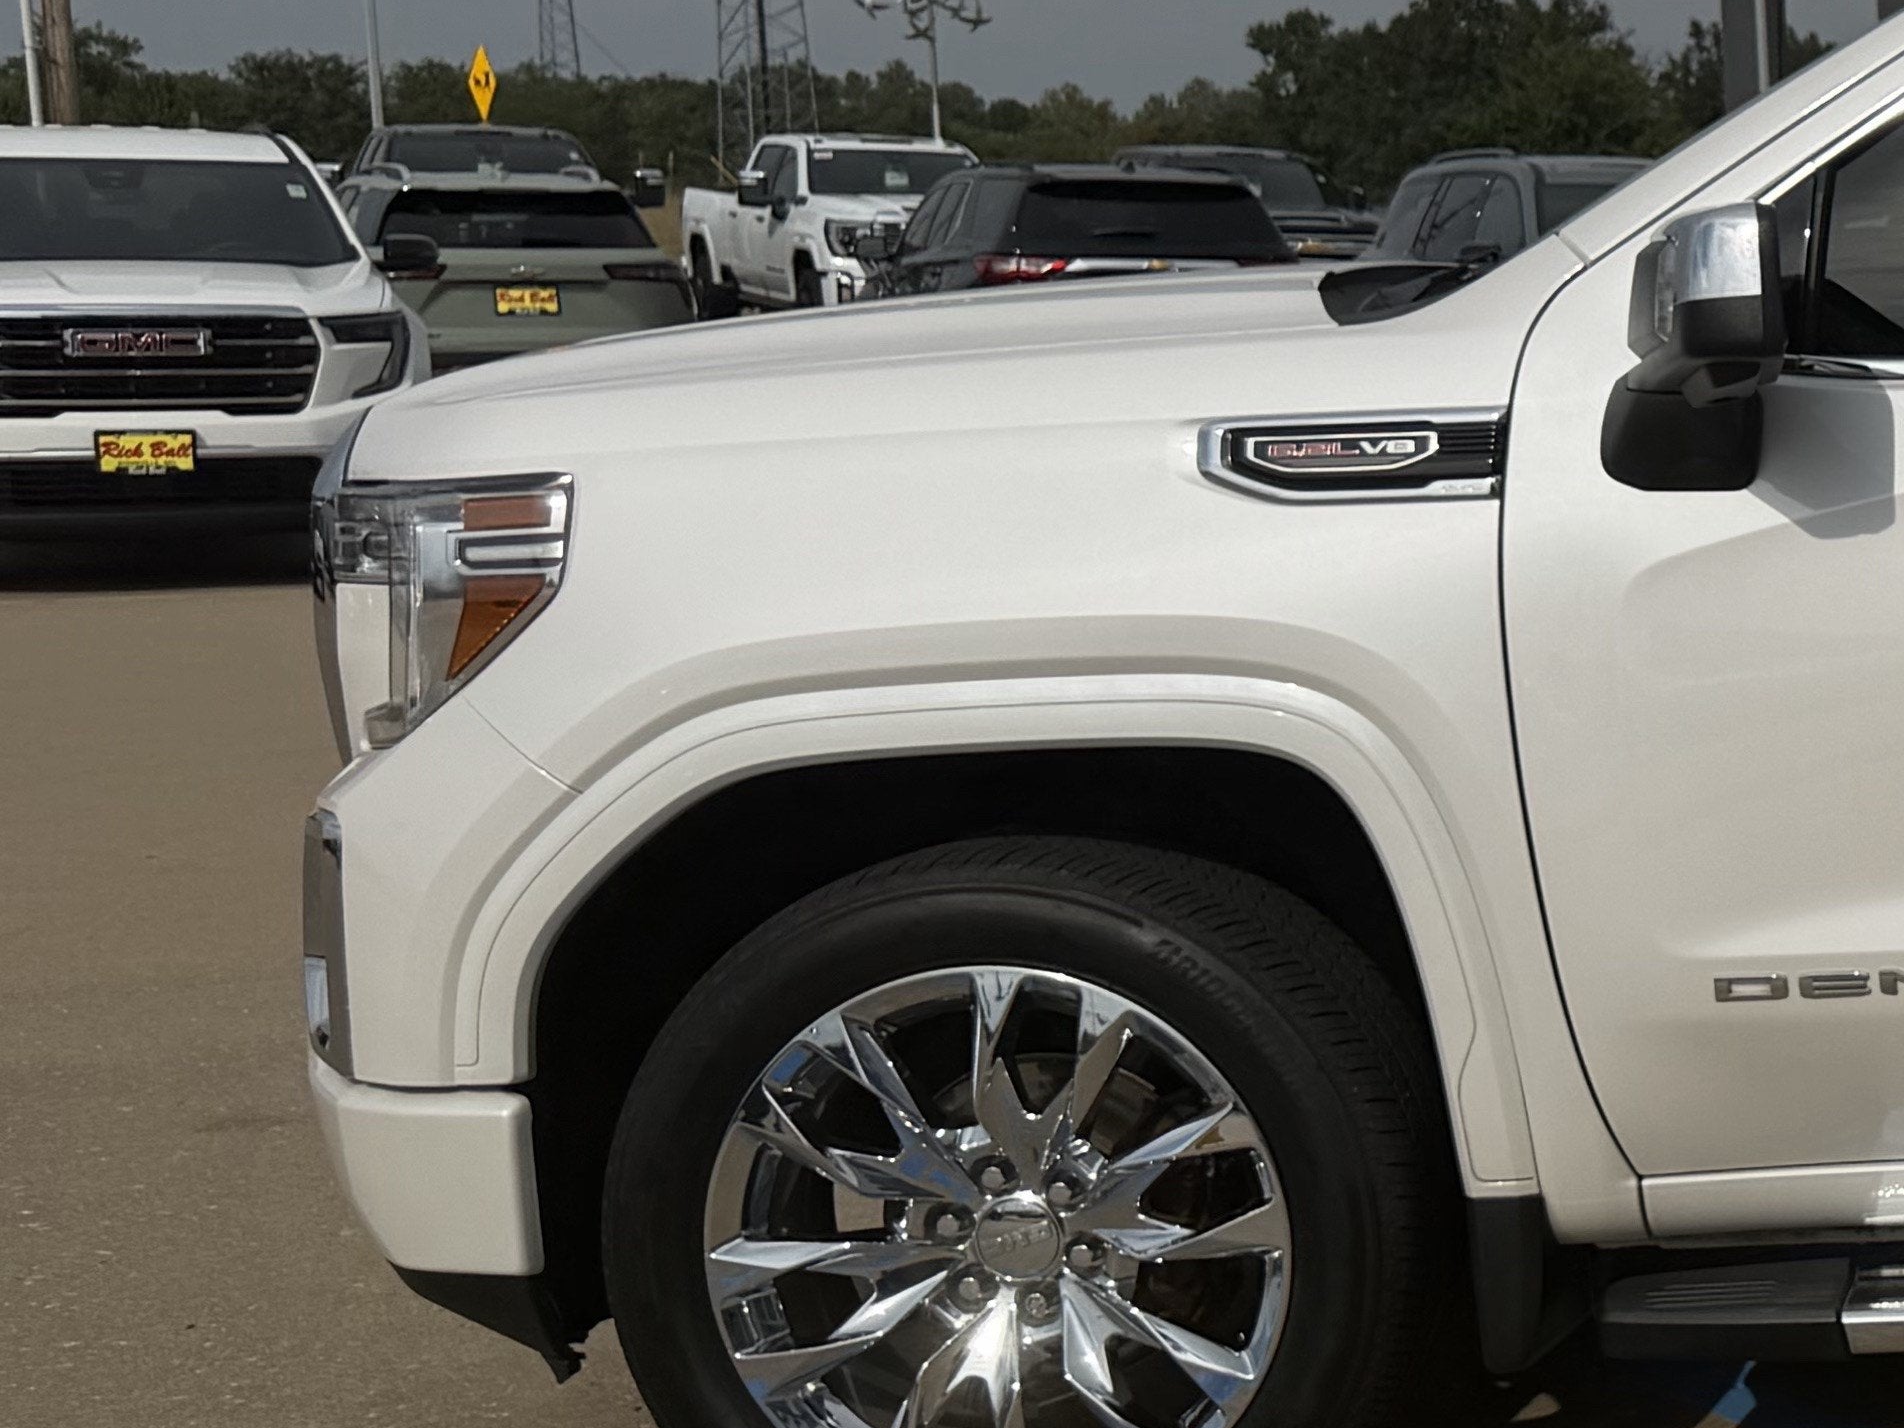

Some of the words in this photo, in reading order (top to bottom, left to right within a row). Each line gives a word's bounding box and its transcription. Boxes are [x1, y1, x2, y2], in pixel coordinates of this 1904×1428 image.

[70, 331, 206, 357] GMC
[101, 440, 143, 459] Rick
[149, 440, 191, 459] Ball
